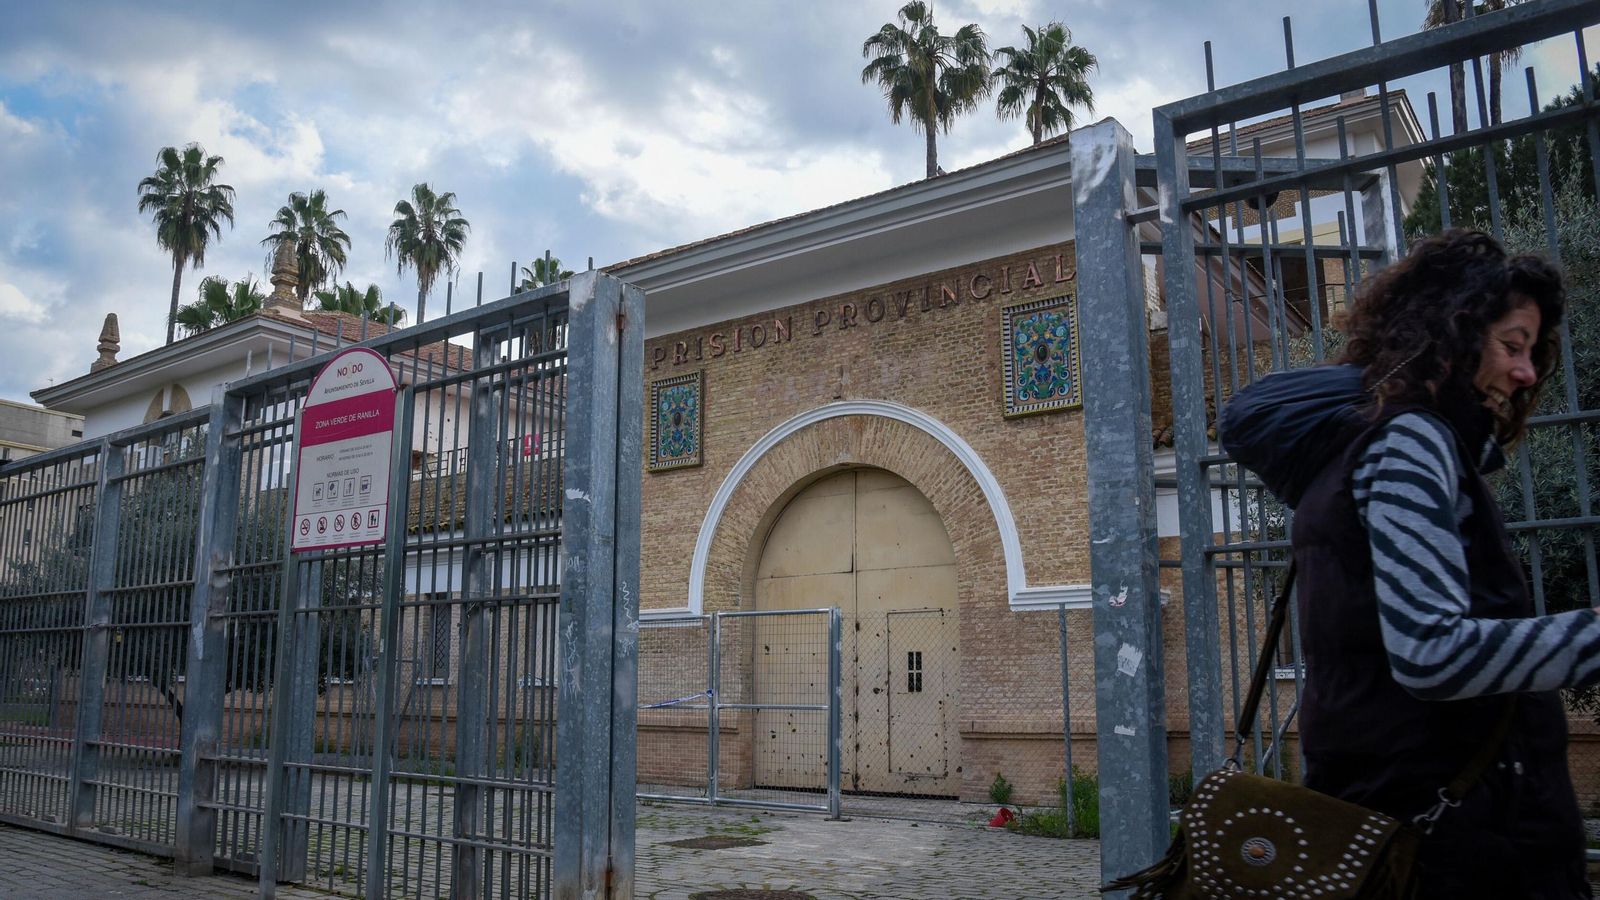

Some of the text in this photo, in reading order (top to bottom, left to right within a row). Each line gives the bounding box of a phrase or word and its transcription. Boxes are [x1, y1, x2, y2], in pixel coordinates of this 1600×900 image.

[651, 253, 1077, 371] PRISION PROVINCIAL
[315, 409, 380, 429] ZONA VERDE DE RANILLA
